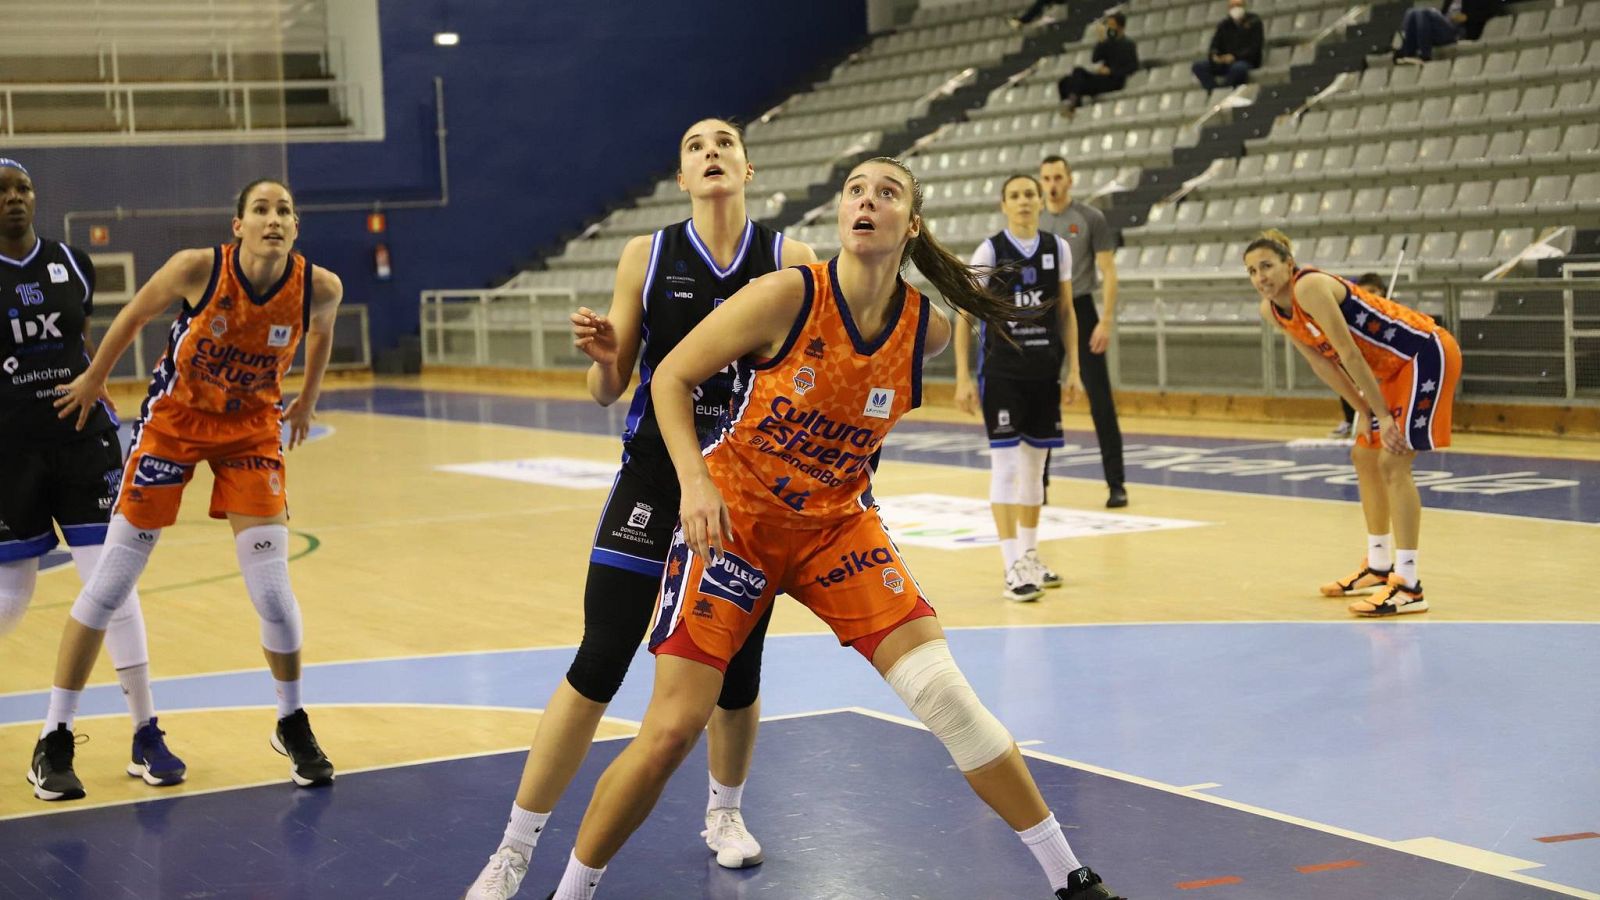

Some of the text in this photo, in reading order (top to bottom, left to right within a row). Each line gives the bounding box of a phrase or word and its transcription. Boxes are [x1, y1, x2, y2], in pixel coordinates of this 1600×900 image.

[1022, 267, 1037, 285] 10
[15, 282, 44, 306] 15
[674, 291, 694, 299] WIBO
[12, 367, 71, 385] euskotren
[771, 395, 873, 447] Cultura
[757, 415, 866, 474] Esfuerz
[772, 476, 811, 512] 14
[612, 530, 654, 545] SAN SEBASTIAN
[620, 526, 647, 537] DONOSTIA
[711, 554, 767, 590] PULEVA
[815, 546, 894, 588] teika
